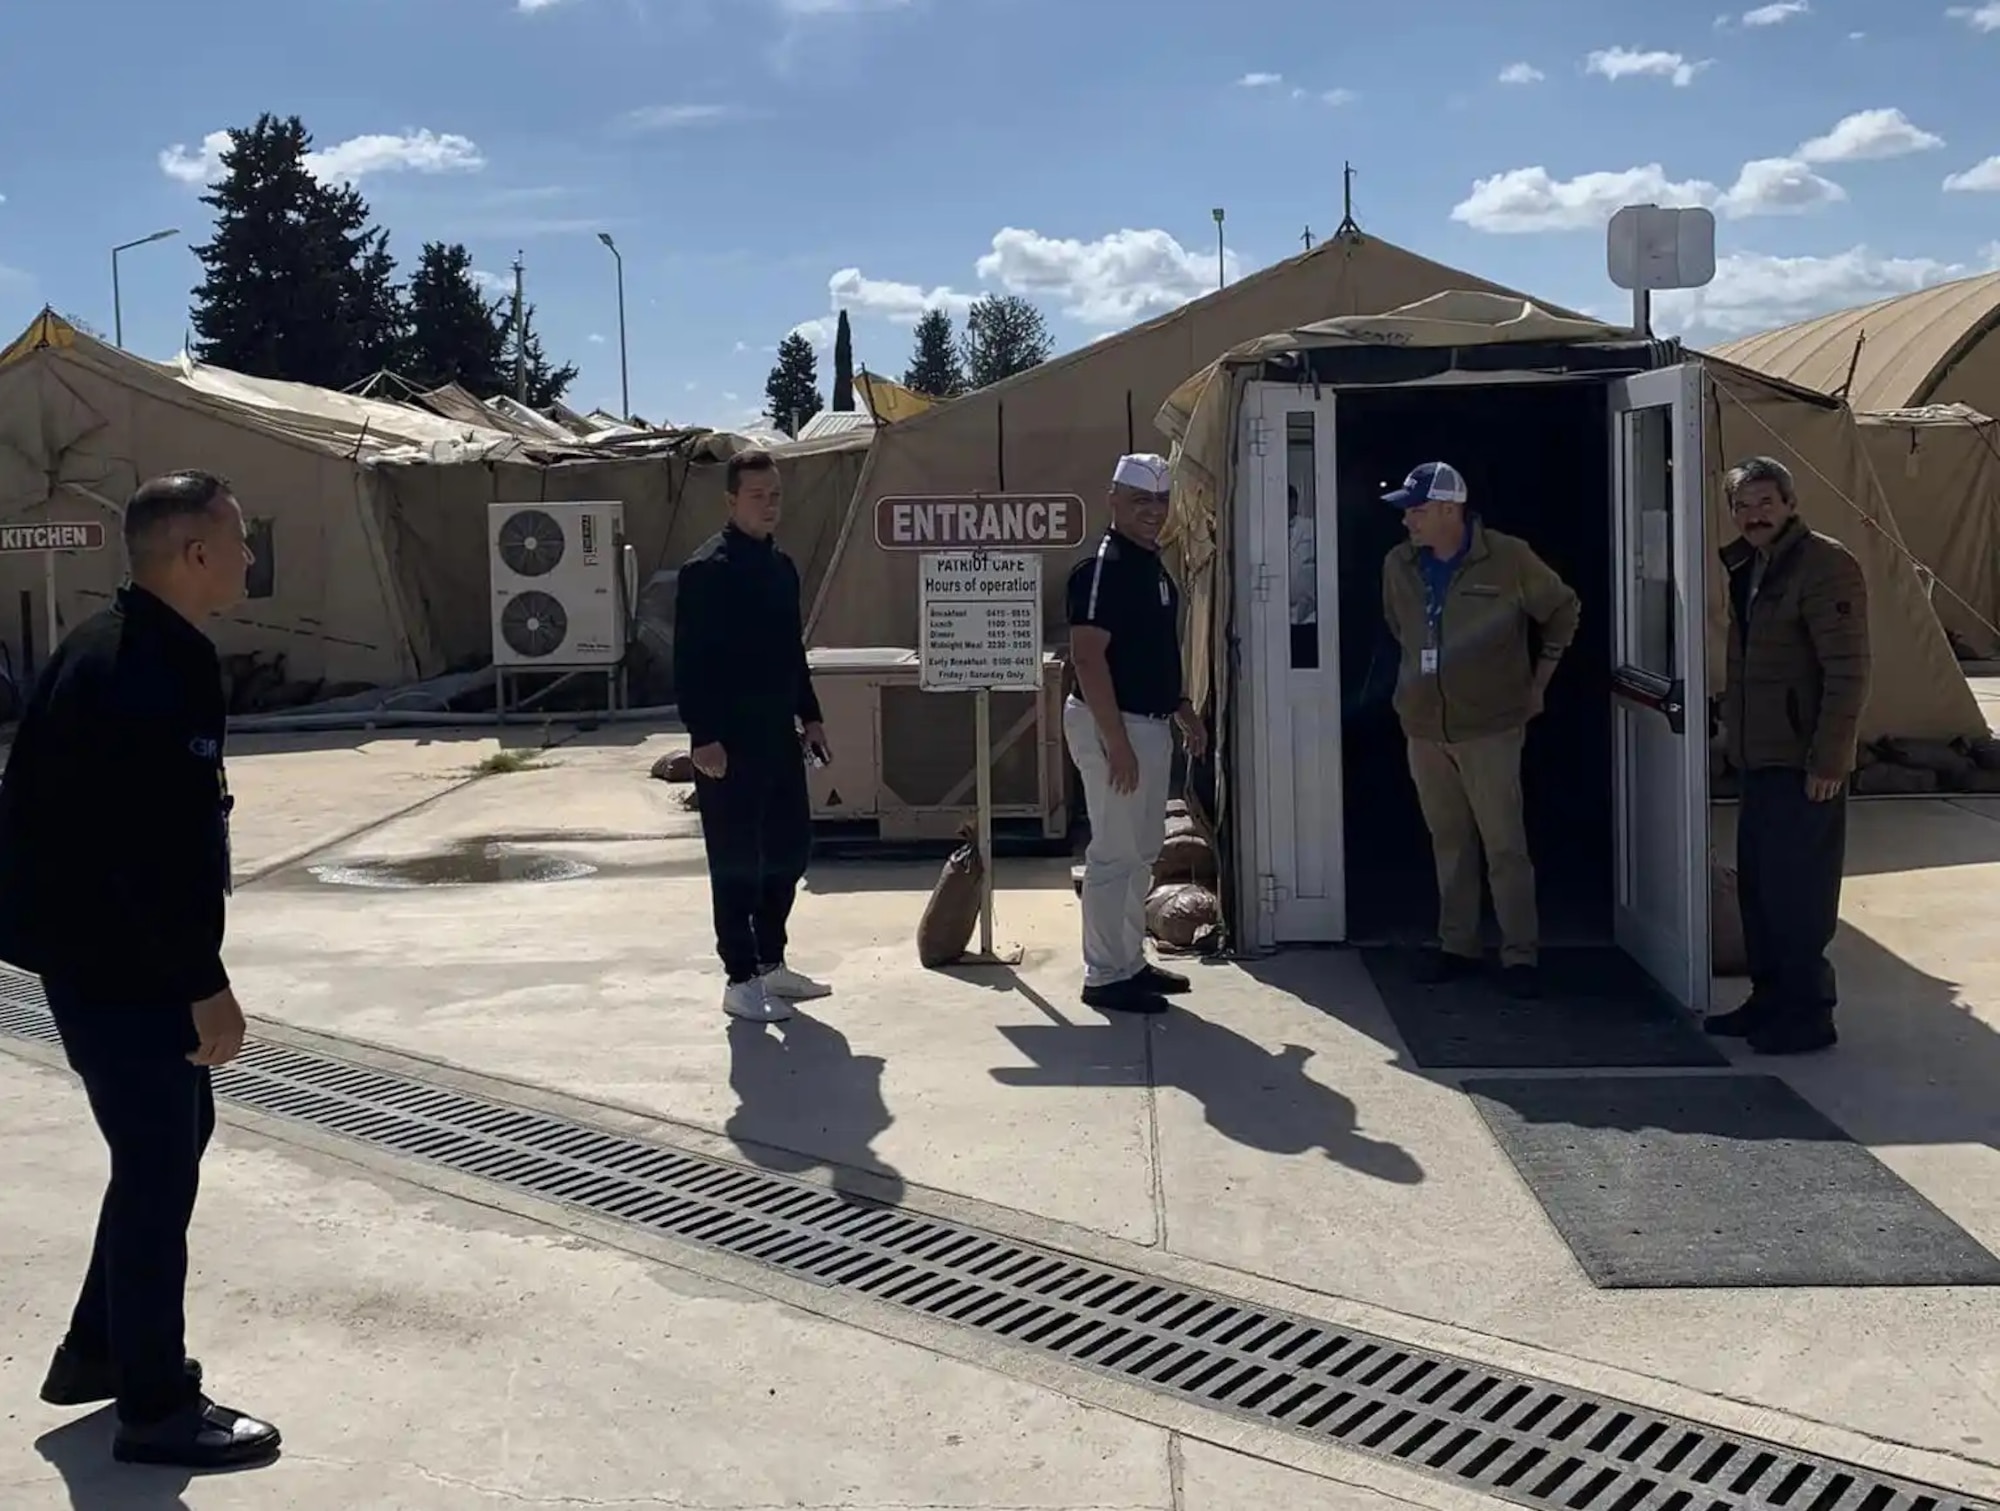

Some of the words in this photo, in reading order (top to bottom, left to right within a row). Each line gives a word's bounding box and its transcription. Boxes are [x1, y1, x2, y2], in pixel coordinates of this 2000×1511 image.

[892, 502, 1068, 542] ENTRANCE
[1, 525, 87, 549] KITCHEN
[937, 558, 987, 573] PATRIOT
[925, 578, 961, 592] Hours
[964, 578, 977, 592] of
[979, 578, 1037, 596] operation
[930, 641, 963, 650] Midnight
[928, 658, 948, 667] Early
[939, 671, 963, 680] Friday
[970, 671, 1005, 679] Saturday
[1006, 671, 1025, 680] Only
